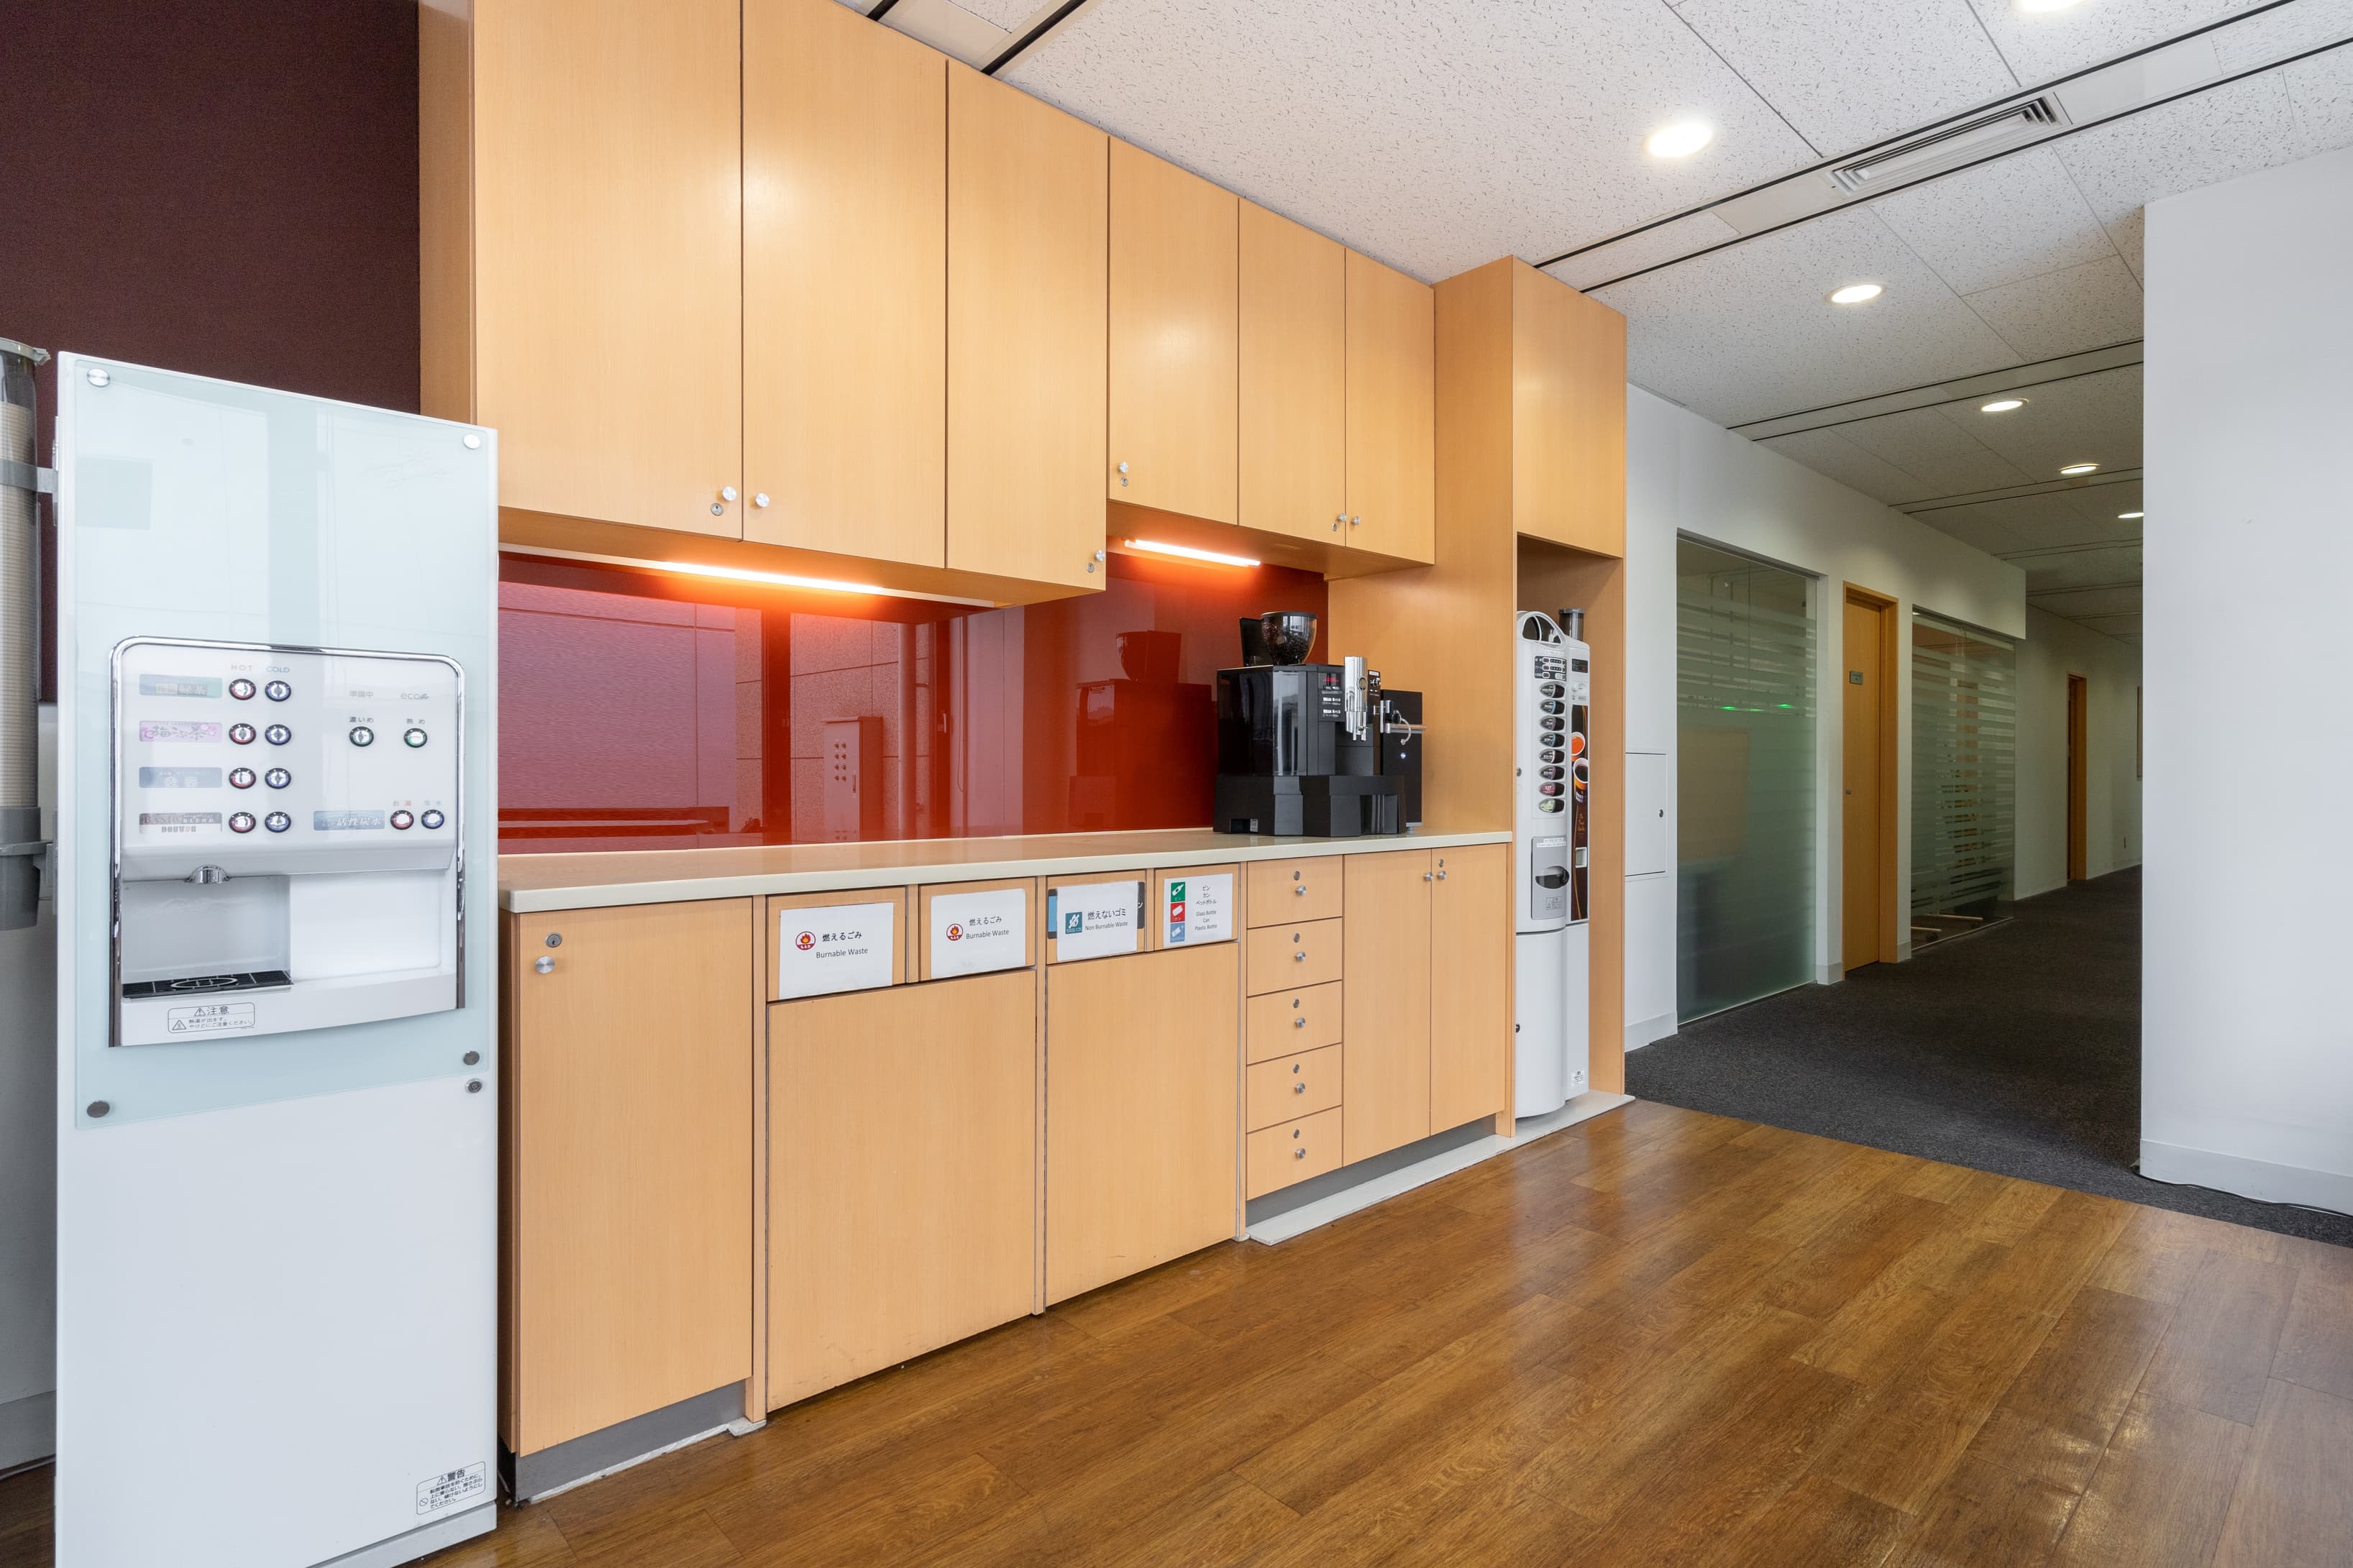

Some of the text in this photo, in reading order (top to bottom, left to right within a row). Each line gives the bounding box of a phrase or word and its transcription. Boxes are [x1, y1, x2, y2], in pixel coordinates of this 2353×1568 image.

[1087, 908, 1126, 920] 燃えないゴミ
[969, 916, 1002, 926] 燃えるごみ
[822, 931, 863, 943] 燃えるごみ
[816, 950, 846, 958] Burnable
[206, 1006, 229, 1015] 注意
